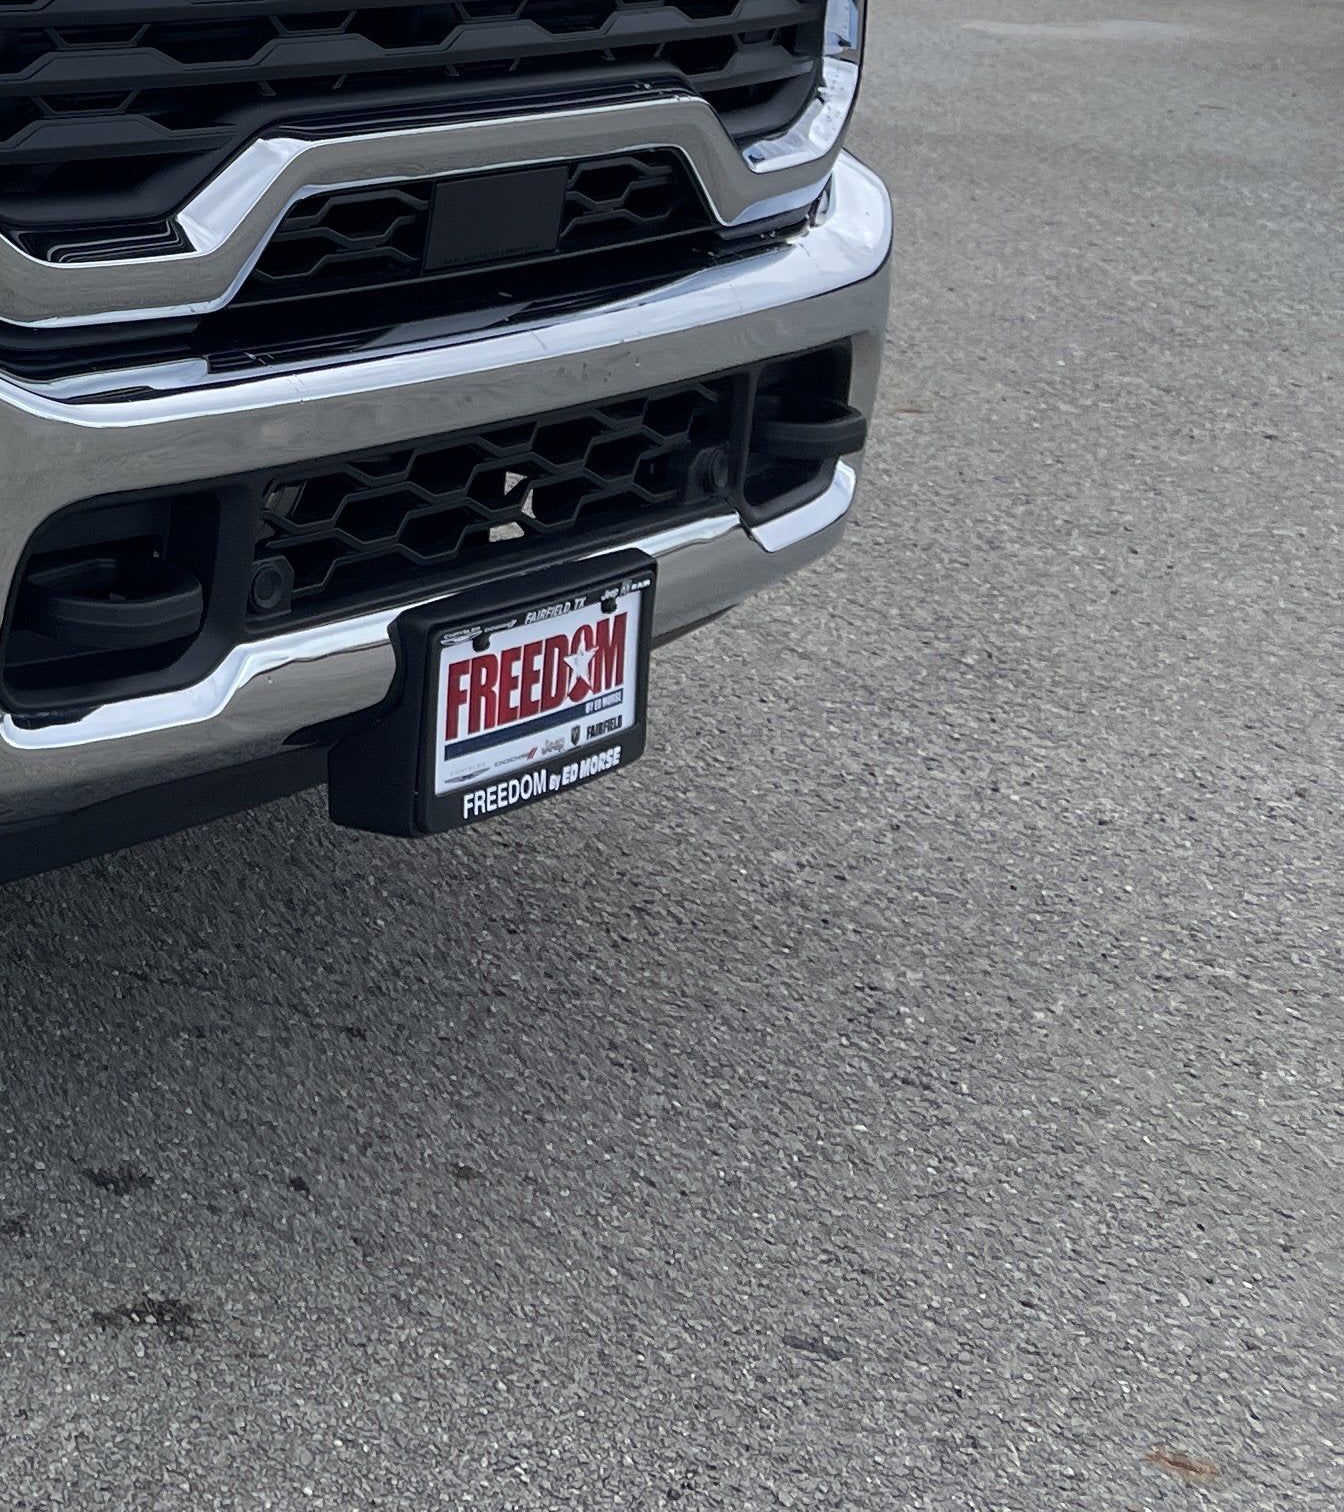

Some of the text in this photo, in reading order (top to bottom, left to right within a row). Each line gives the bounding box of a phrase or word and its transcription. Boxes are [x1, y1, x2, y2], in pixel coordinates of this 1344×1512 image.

[524, 602, 571, 625] FAIRFIELD
[573, 596, 587, 611] TX
[445, 612, 628, 741] FREEDOM
[586, 714, 622, 740] FAIRFIELD
[541, 737, 565, 755] Jeep
[463, 768, 547, 820] FREEDOM
[562, 764, 578, 786] ED
[579, 745, 622, 779] MORSE
